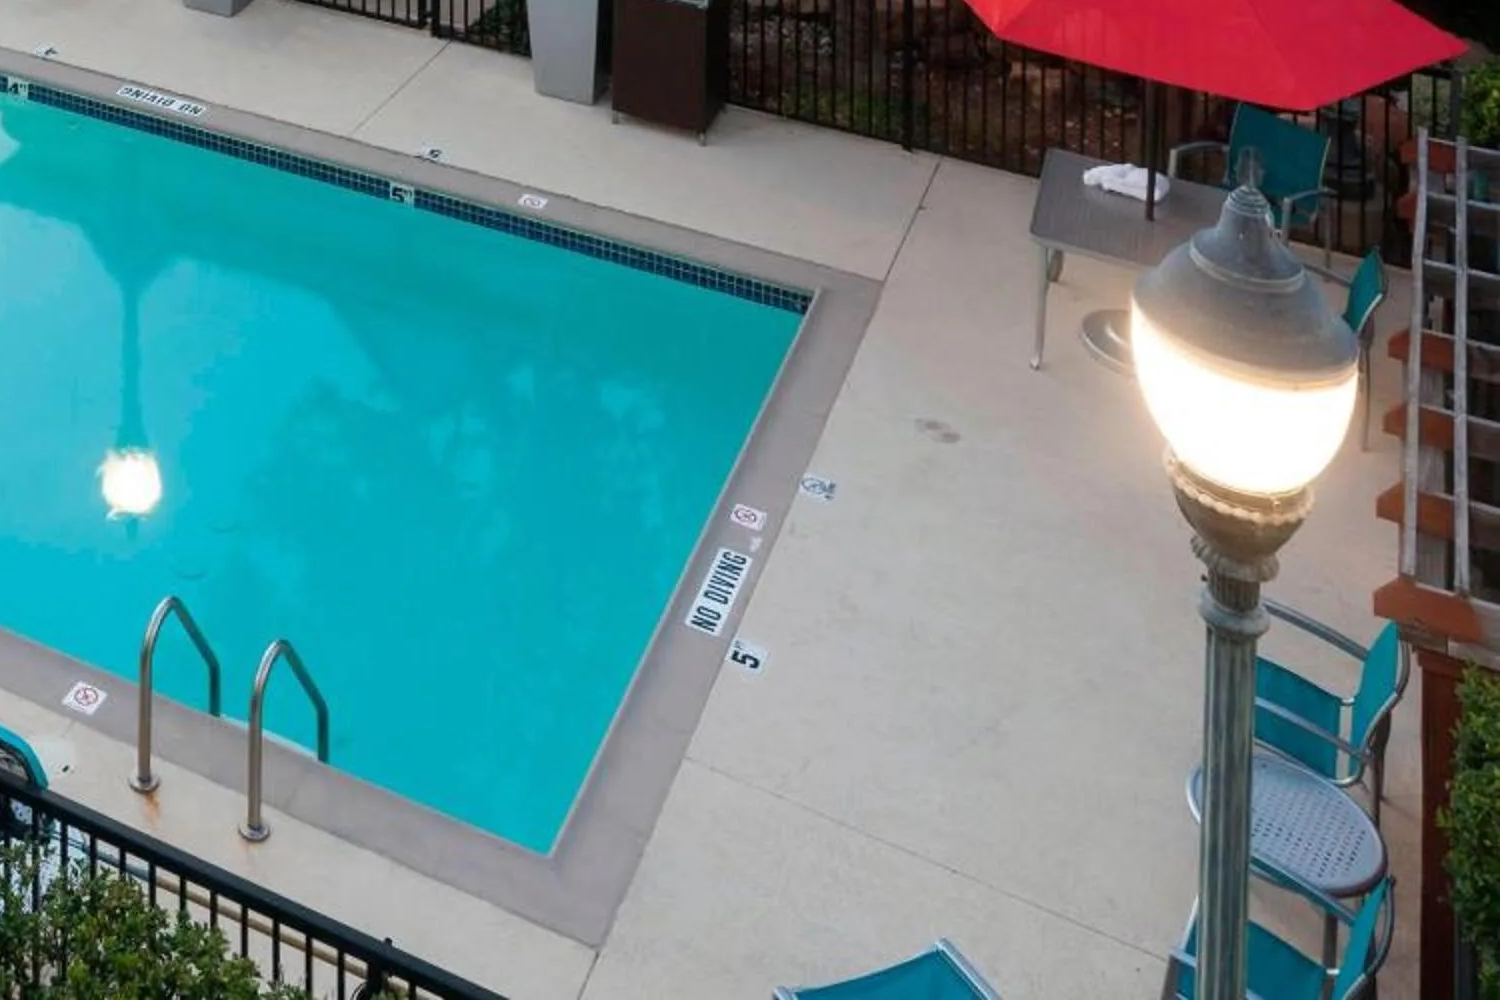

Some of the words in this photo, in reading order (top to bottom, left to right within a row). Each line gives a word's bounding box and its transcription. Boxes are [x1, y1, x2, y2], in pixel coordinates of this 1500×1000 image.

[703, 551, 748, 606] DIVING
[690, 605, 722, 633] NO
[730, 649, 761, 670] 5
